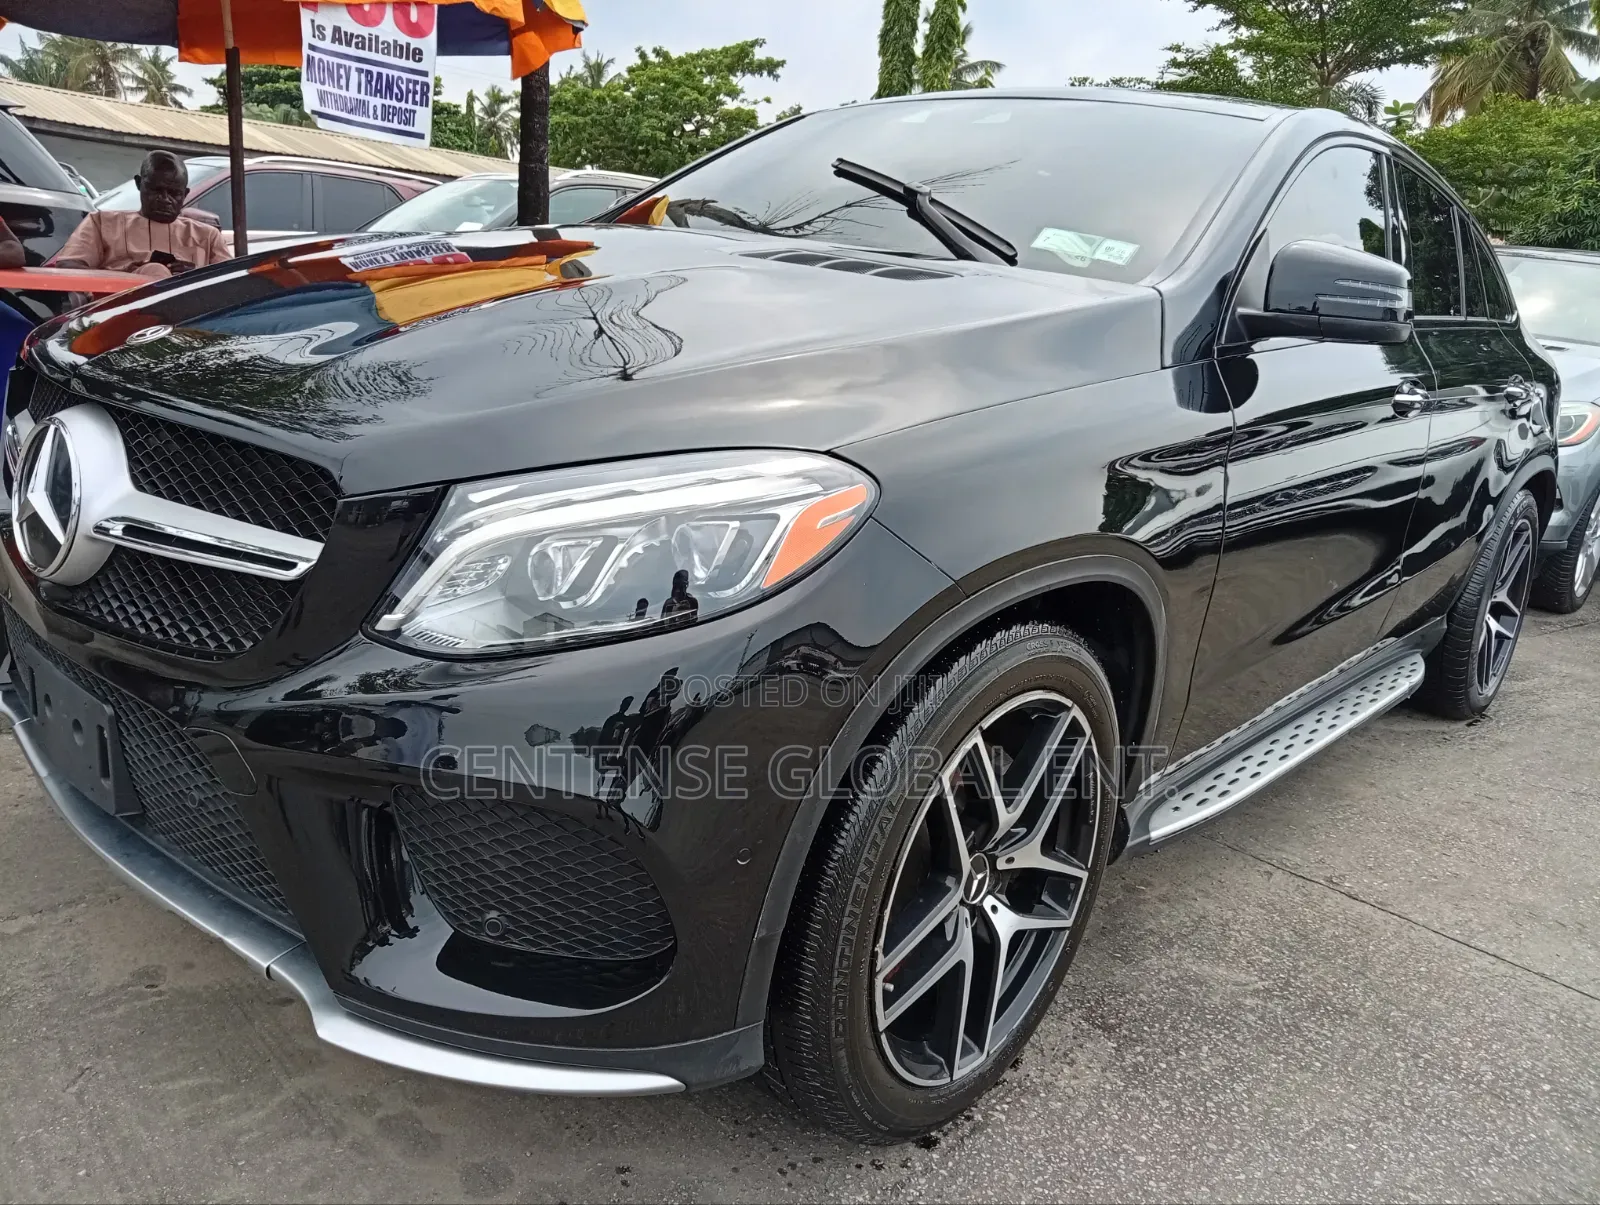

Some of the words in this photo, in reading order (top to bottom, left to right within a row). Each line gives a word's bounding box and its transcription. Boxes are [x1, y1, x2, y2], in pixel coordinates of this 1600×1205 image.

[310, 18, 327, 42] Is
[330, 25, 424, 63] Available
[306, 53, 352, 92] MONEY
[354, 66, 430, 108] TRANSFER
[316, 88, 370, 119] WITHDRAWAL
[372, 104, 379, 120] &
[380, 103, 417, 128] DEPOSIT
